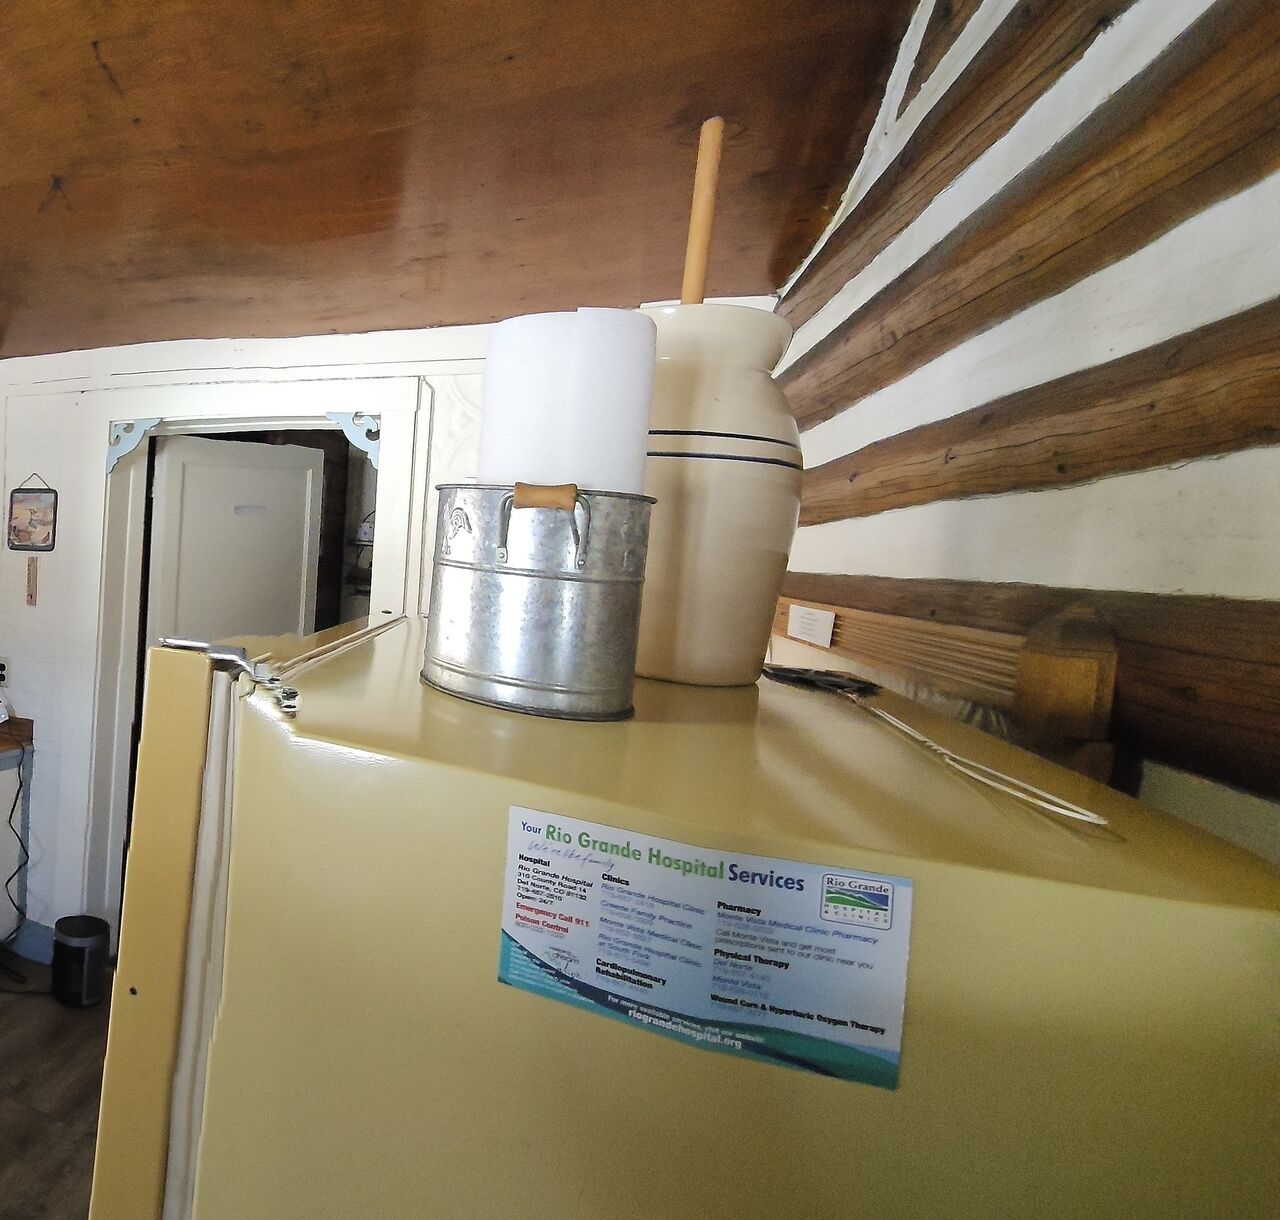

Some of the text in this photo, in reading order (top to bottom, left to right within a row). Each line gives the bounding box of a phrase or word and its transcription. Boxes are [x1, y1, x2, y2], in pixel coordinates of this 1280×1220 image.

[518, 853, 551, 868] Hospital
[521, 820, 805, 892] Your Rio Grande Hospital Services
[517, 878, 529, 886] Del
[518, 864, 594, 888] Rio Grande Hospital
[531, 875, 556, 886] County
[558, 880, 577, 890] Road
[601, 873, 630, 887] Clinics
[826, 877, 889, 894] Rio Grande
[601, 883, 615, 891] Rio
[616, 886, 646, 899] Grande
[647, 894, 682, 909] Hospital
[682, 903, 705, 915] Clinic
[717, 900, 762, 917] Pharmacy
[516, 902, 589, 928] Emergency Call 911
[824, 903, 888, 918] HOSPITAL
[515, 913, 569, 934] Poison Control
[658, 915, 693, 930] Practice
[767, 919, 804, 932] Medical
[804, 925, 830, 936] Clinic
[831, 930, 879, 945] Pharmacy
[646, 929, 679, 944] Medical
[679, 938, 704, 951] Clinic
[814, 946, 836, 955] most
[713, 948, 790, 970] Physical Therapy
[595, 966, 653, 989] Rehabilitation
[596, 957, 667, 986] Cardiopulmonary
[607, 994, 619, 1004] For
[710, 993, 739, 1006] Wound
[739, 999, 759, 1009] Care
[760, 1003, 767, 1011] &
[769, 1005, 815, 1021] Hyperbaric
[816, 1014, 849, 1027] Oxygen
[849, 1020, 886, 1036] Therapy
[627, 1008, 742, 1050] riograndehospital.org
